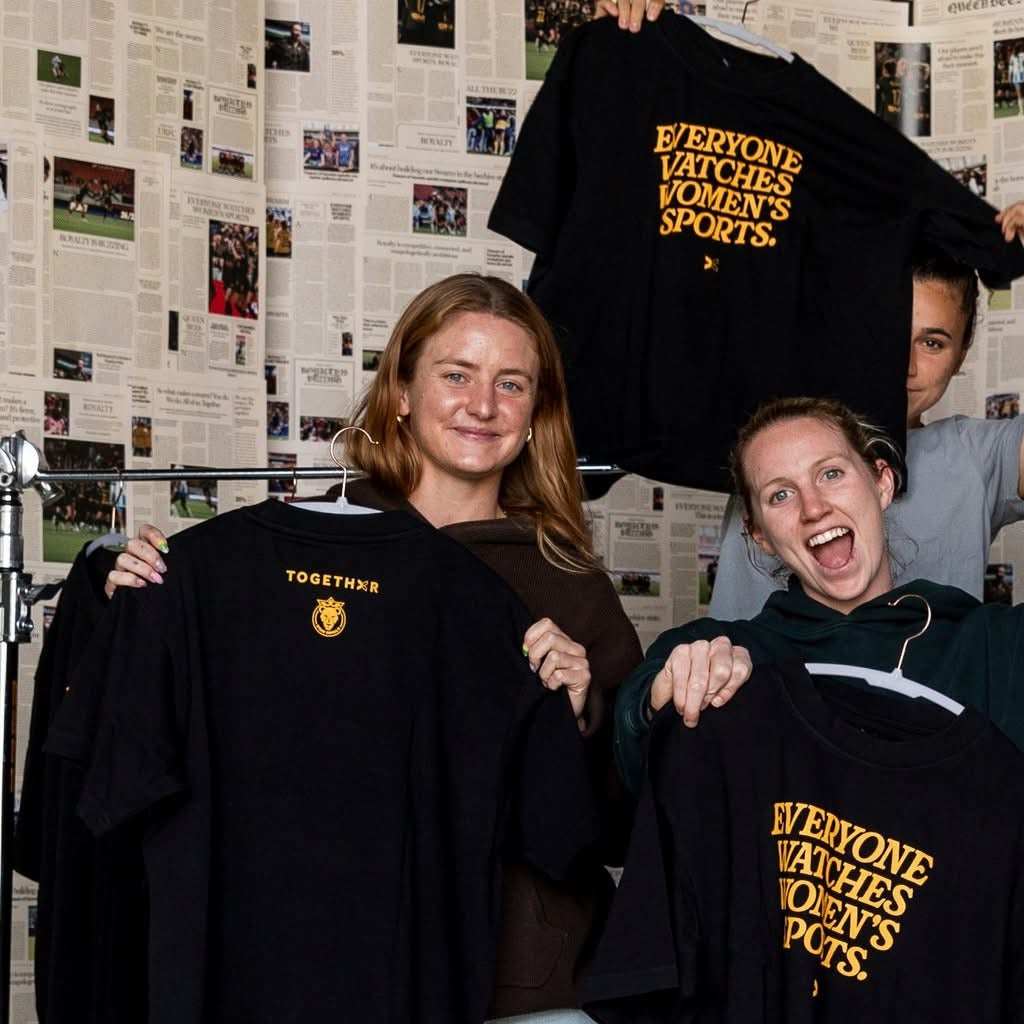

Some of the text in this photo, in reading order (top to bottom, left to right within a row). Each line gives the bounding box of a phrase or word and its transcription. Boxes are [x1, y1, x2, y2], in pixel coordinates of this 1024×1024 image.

[654, 122, 803, 174] EVERYONE
[660, 207, 776, 247] SPORTS.
[771, 802, 934, 886] EVERYONE
[777, 840, 914, 916] WATCHES
[784, 916, 868, 981] POTS.
